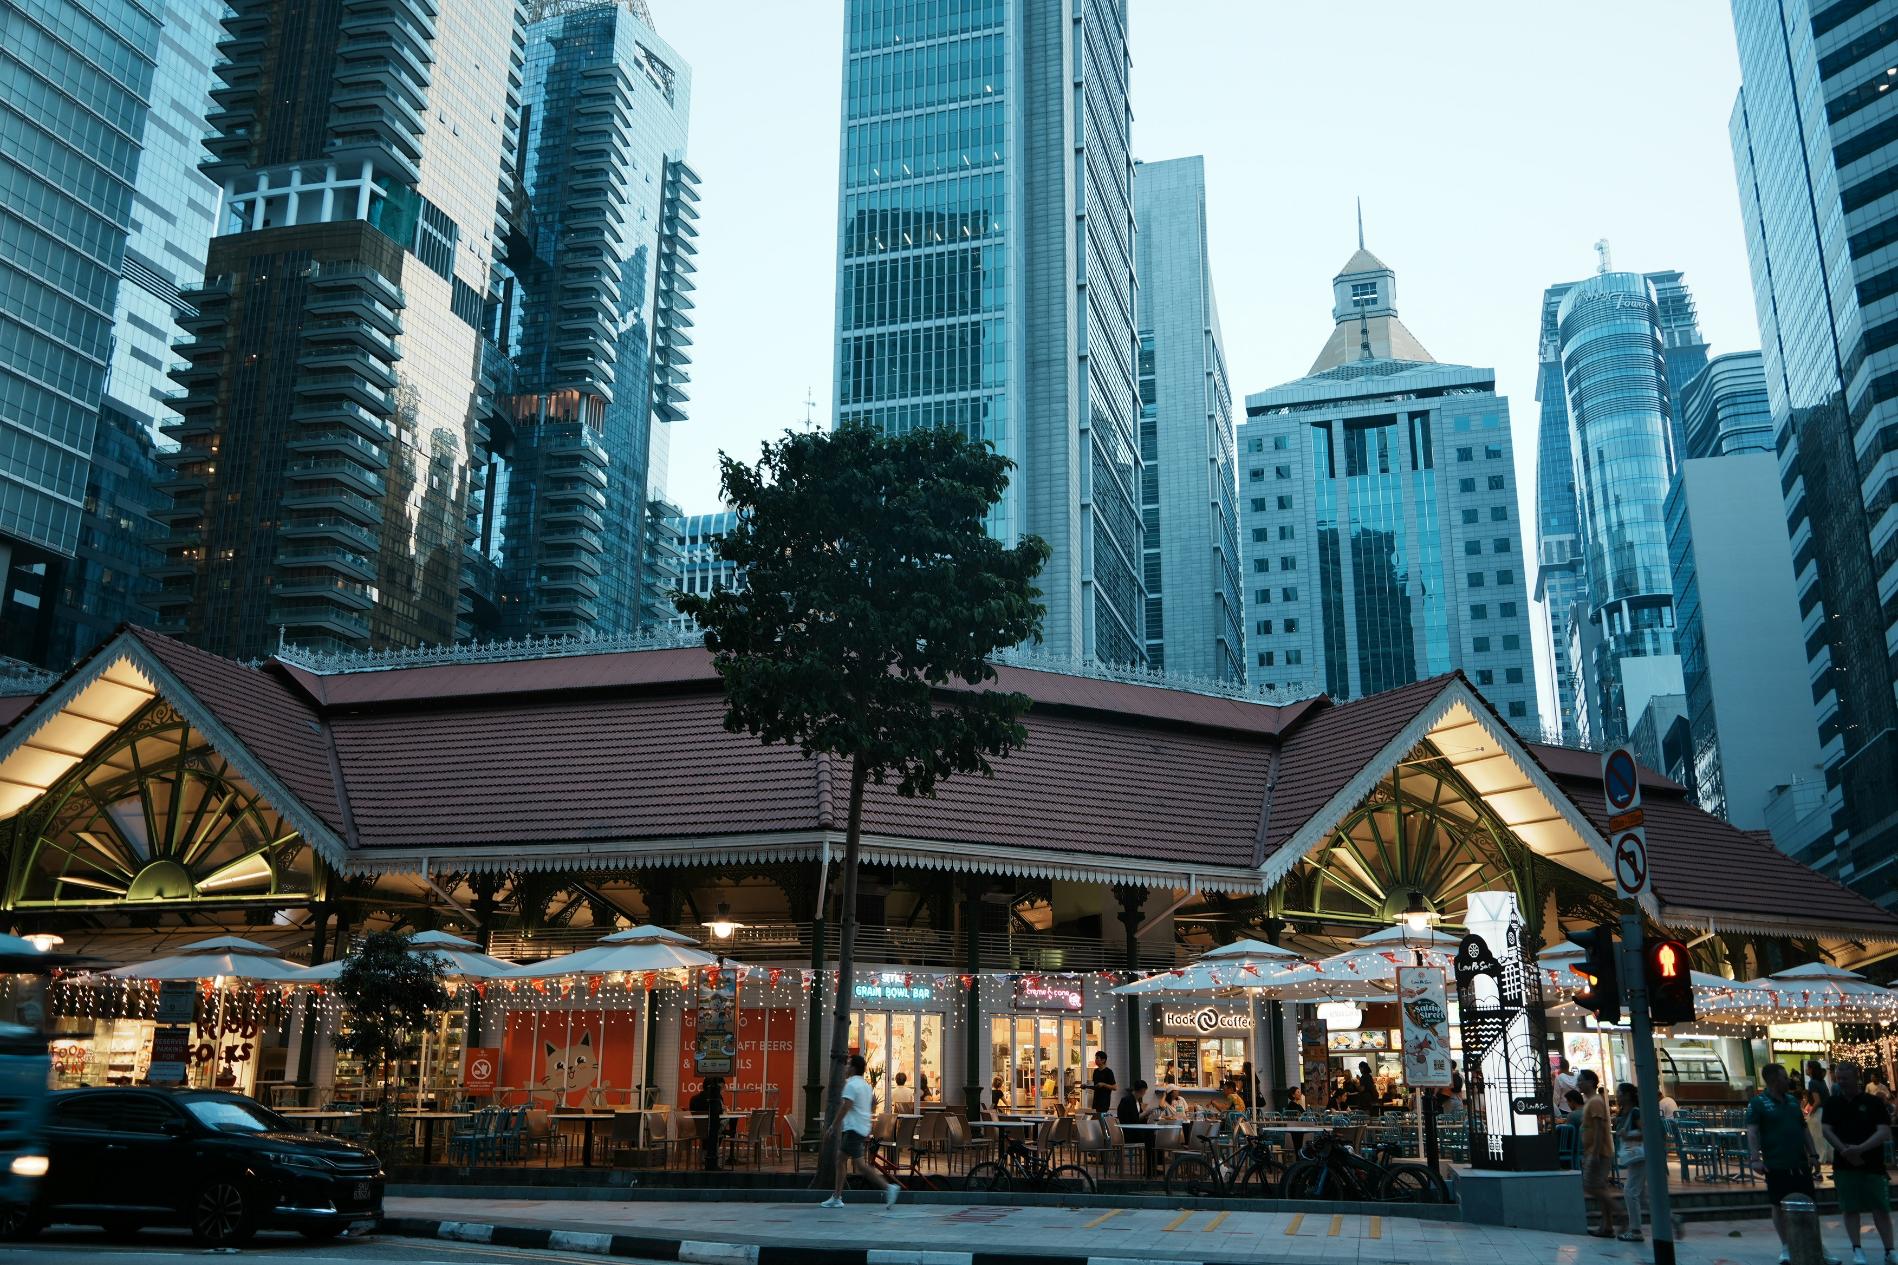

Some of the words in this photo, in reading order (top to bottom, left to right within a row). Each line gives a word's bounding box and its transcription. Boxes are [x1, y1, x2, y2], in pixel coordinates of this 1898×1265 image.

[1609, 291, 1650, 310] Tower
[856, 986, 881, 997] GRAIN
[885, 987, 909, 998] BOWL
[913, 988, 930, 999] BAR
[1166, 1014, 1196, 1025] Hook
[196, 1020, 258, 1040] FOOD
[760, 1041, 793, 1051] BEERS
